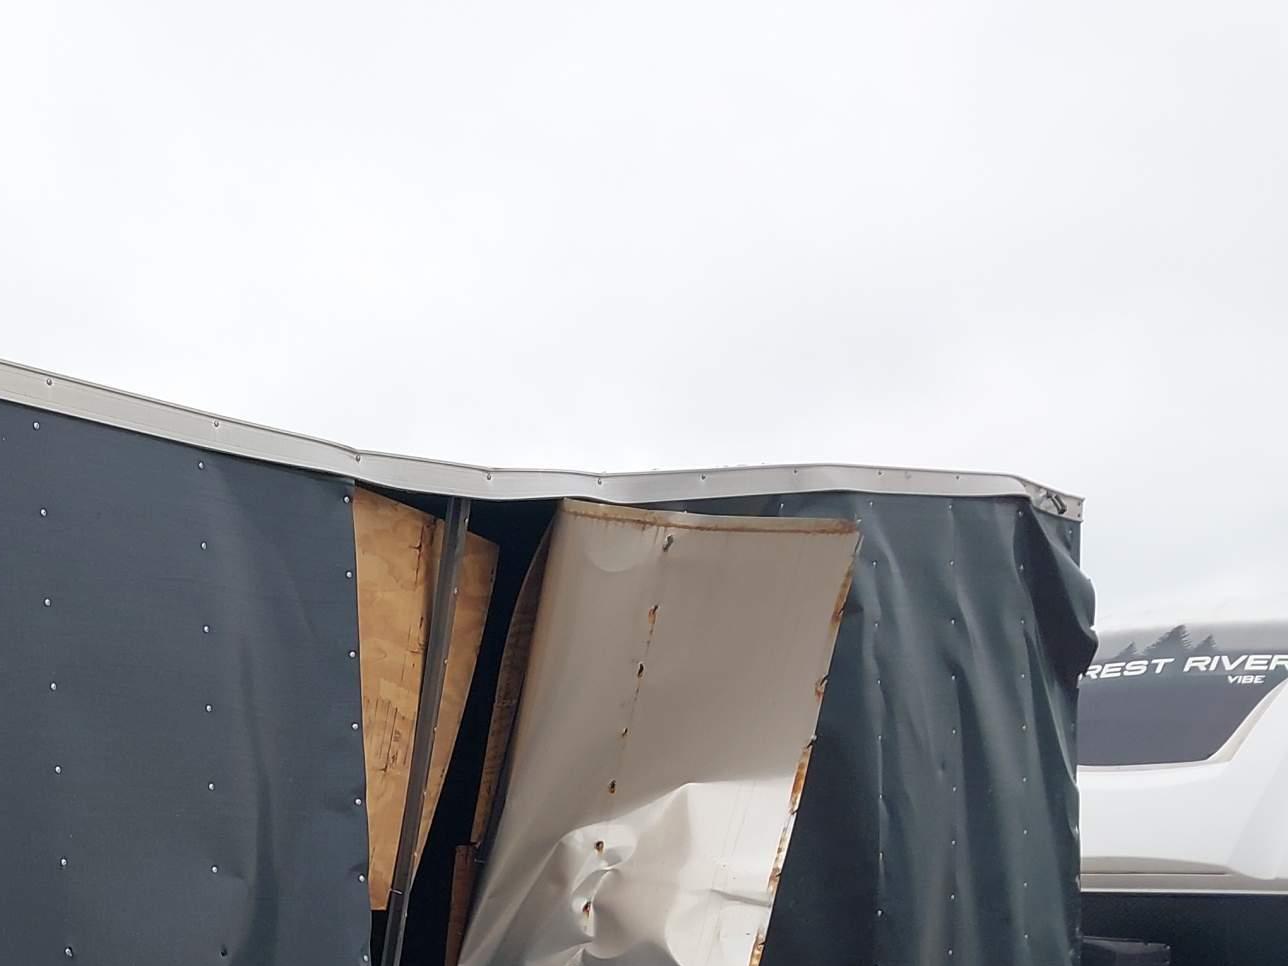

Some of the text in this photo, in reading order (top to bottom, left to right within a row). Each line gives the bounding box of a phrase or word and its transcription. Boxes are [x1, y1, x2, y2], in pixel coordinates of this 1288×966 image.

[1078, 654, 1288, 680] REST RIVER
[1227, 674, 1266, 684] VIBE
